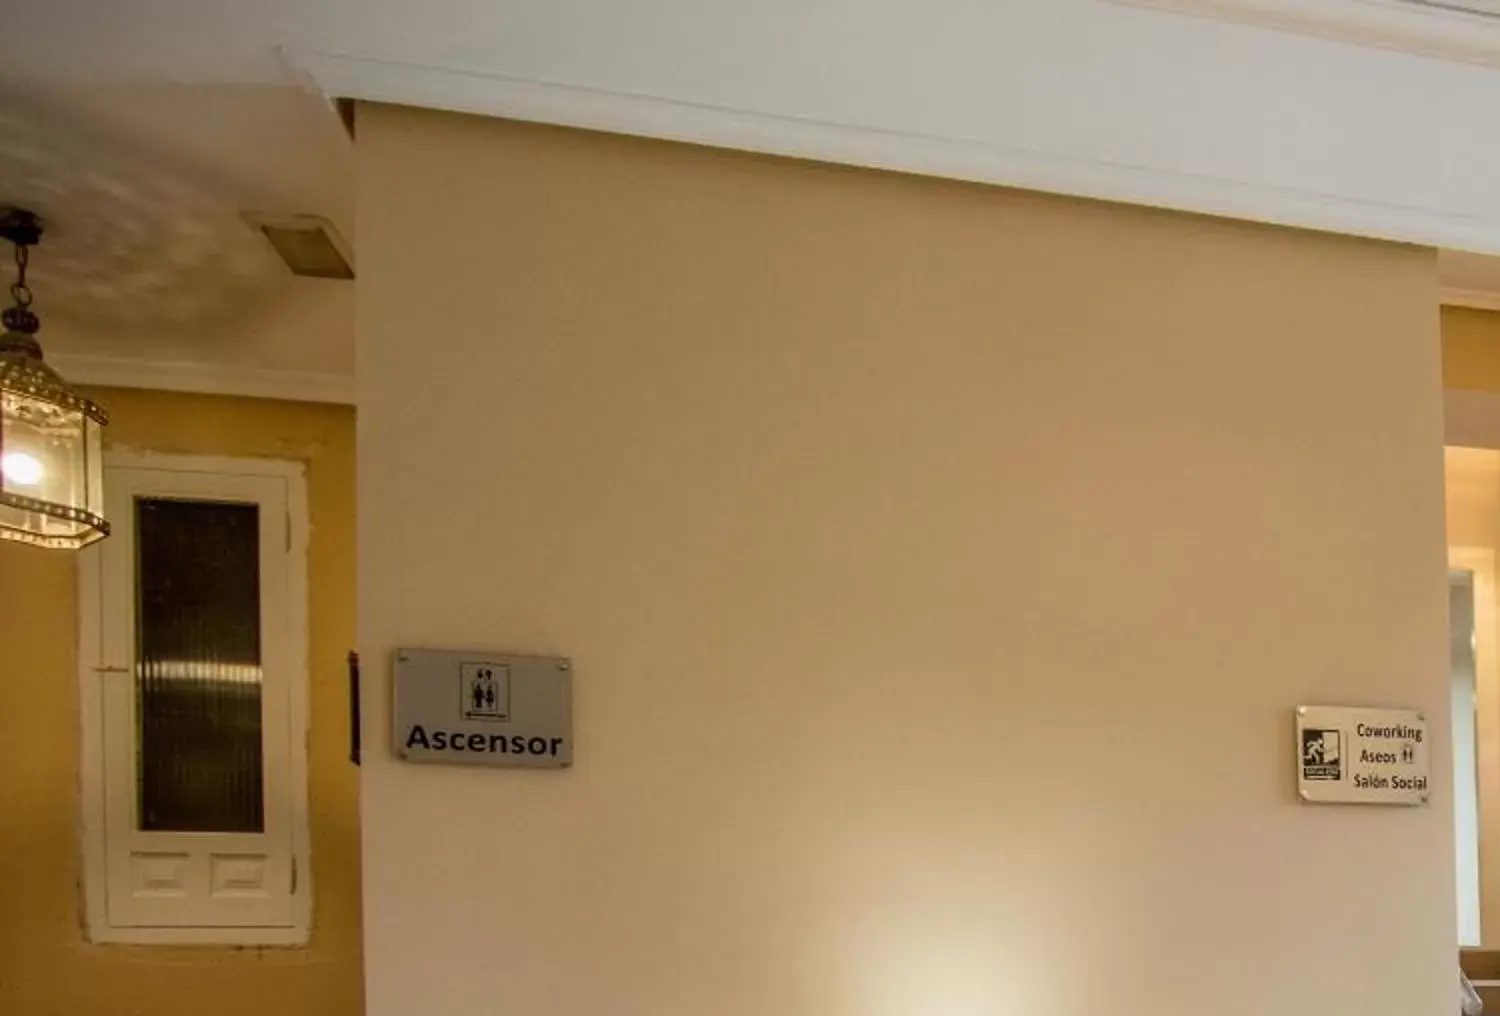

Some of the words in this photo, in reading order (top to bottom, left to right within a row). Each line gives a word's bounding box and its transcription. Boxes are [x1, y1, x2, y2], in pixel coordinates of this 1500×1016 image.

[407, 724, 563, 757] Ascensor
[1357, 723, 1423, 742] Coworking
[1360, 749, 1397, 763] Aseos
[1353, 774, 1389, 788] Salón
[1392, 776, 1427, 790] Social
